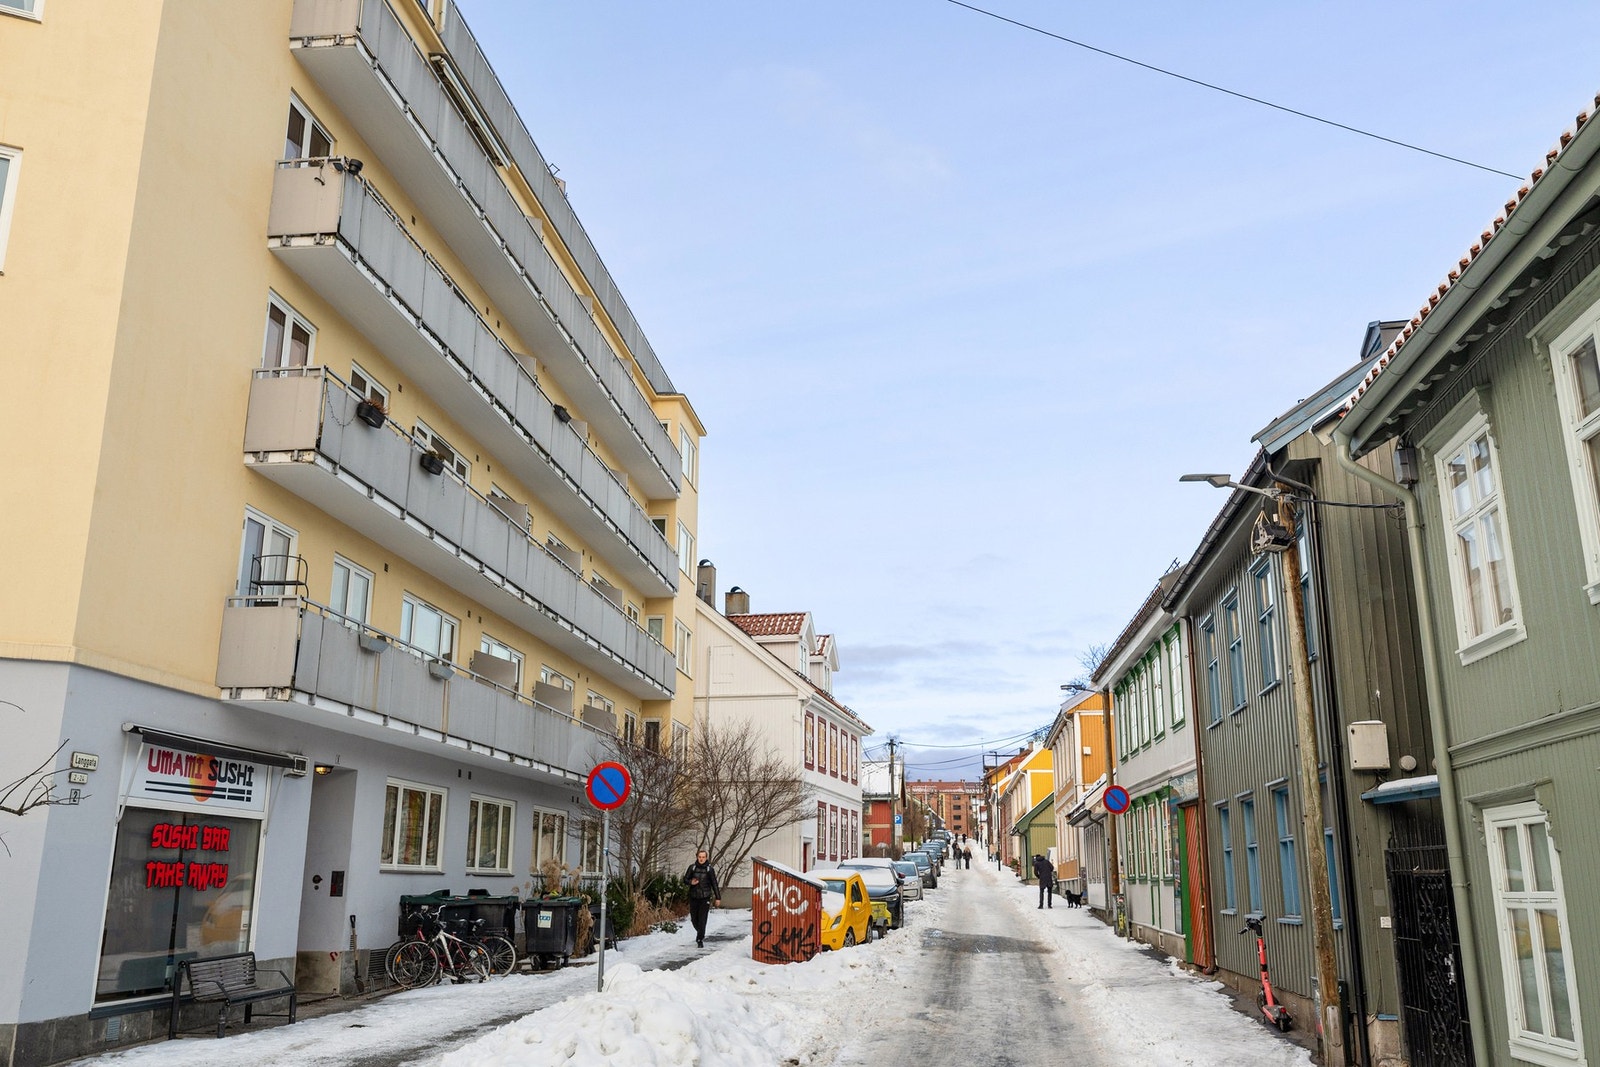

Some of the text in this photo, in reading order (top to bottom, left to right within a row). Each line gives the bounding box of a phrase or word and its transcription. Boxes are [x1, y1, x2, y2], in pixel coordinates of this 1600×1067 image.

[148, 748, 254, 786] UMAMI SUSHI
[72, 790, 78, 802] 2
[152, 823, 231, 851] SUSHI BAR
[146, 862, 228, 890] TAKE AWAY
